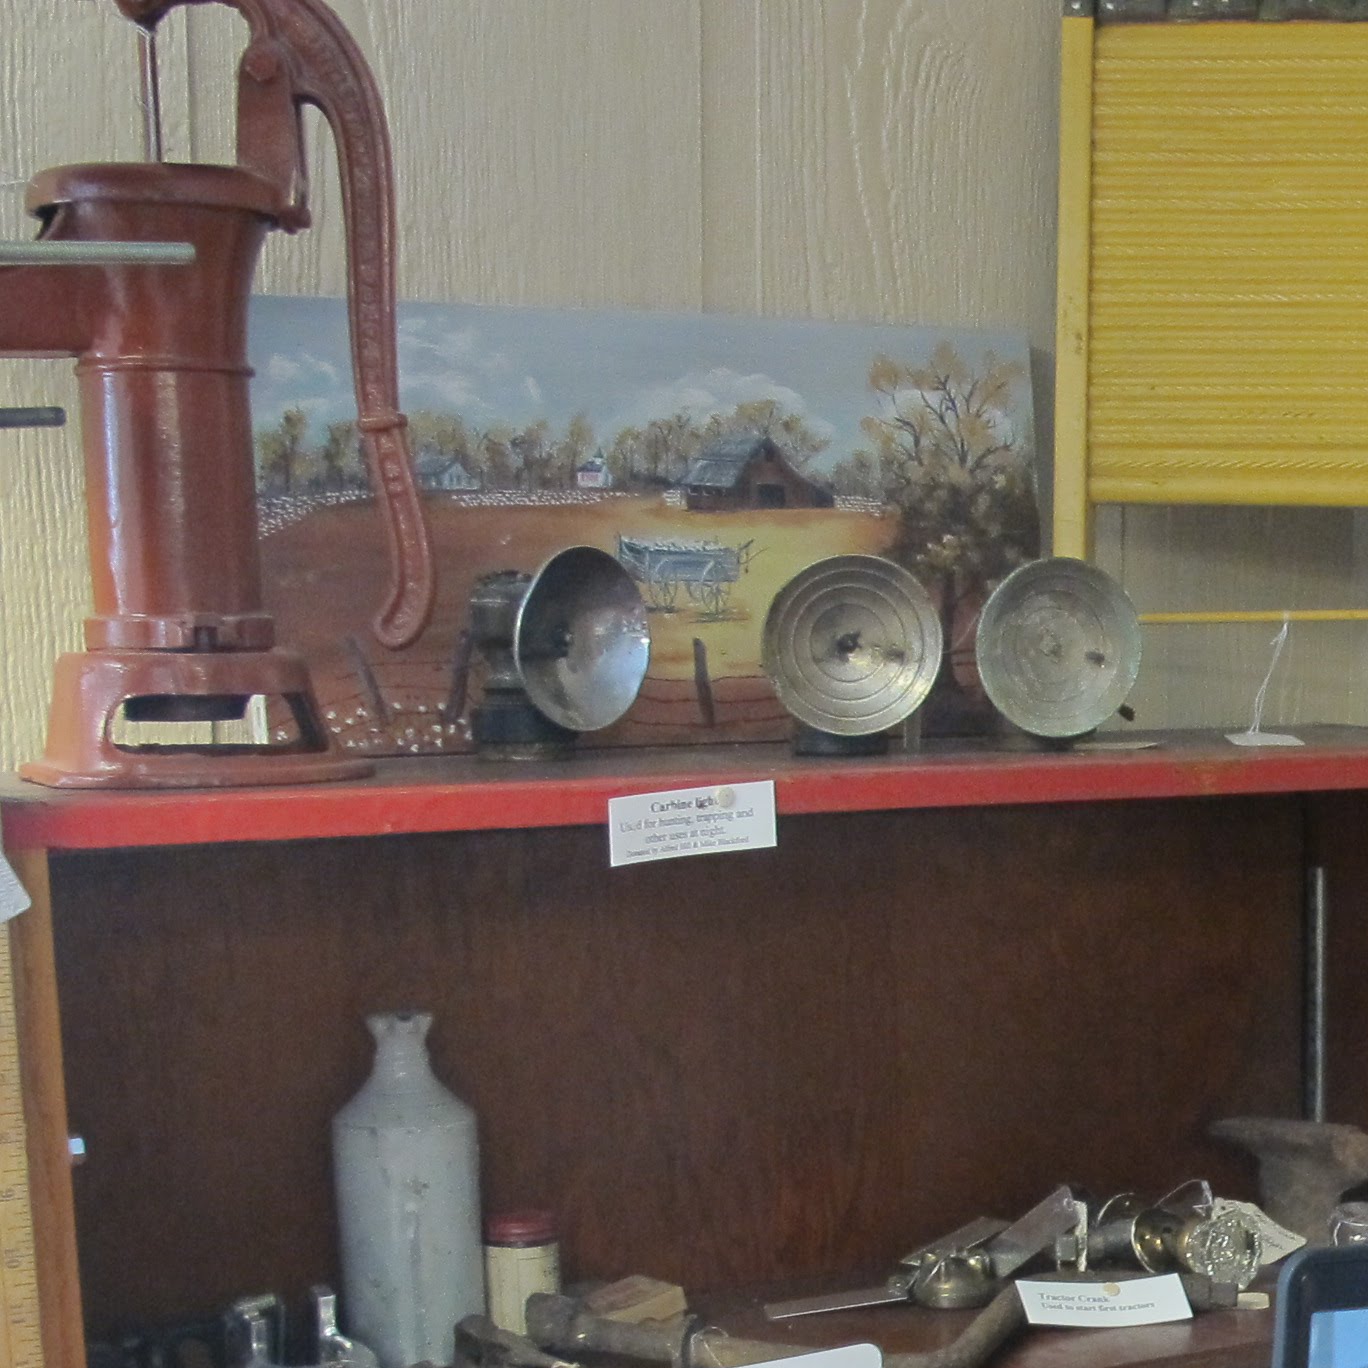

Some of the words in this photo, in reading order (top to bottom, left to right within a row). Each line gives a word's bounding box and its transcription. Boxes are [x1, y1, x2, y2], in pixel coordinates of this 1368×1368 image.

[736, 807, 754, 818] and
[1039, 1292, 1076, 1302] Tractor
[1078, 1294, 1110, 1302] Crank
[1041, 1302, 1063, 1311] Used
[1064, 1303, 1074, 1311] to
[1076, 1304, 1096, 1312] start
[1098, 1304, 1117, 1312] first
[1118, 1301, 1155, 1312] tractors
